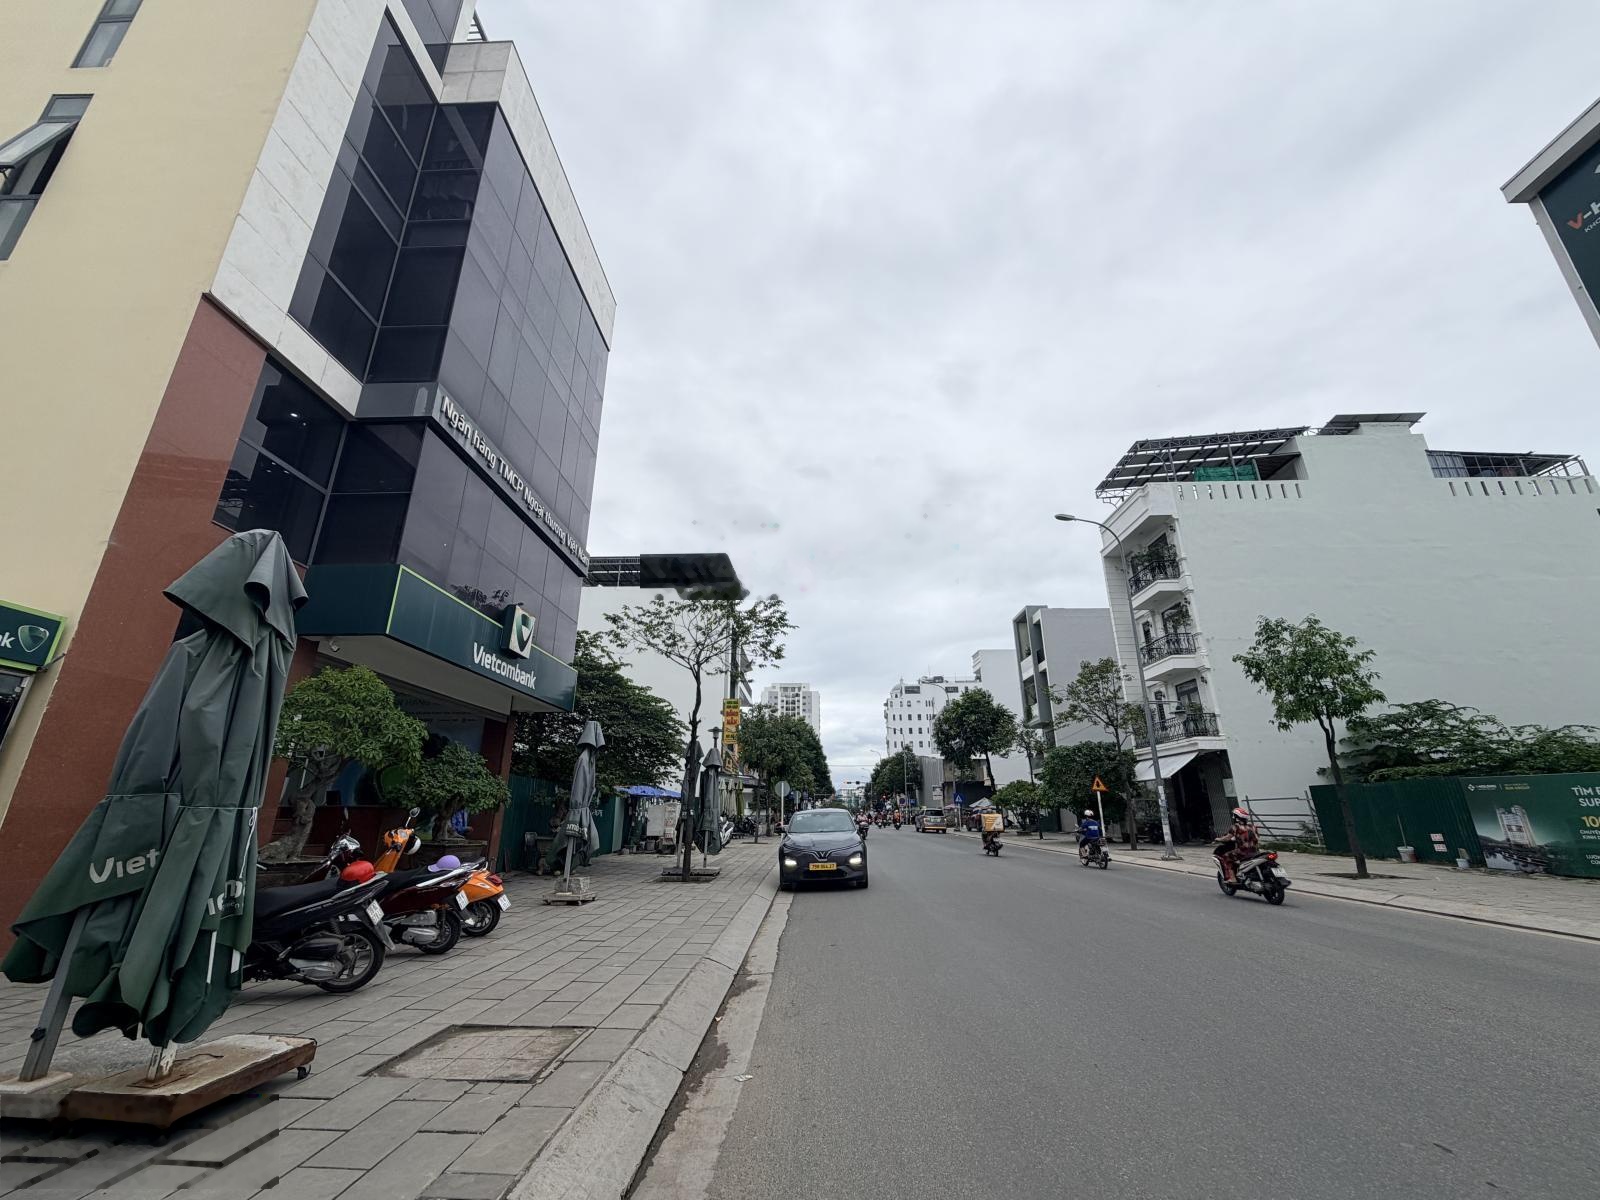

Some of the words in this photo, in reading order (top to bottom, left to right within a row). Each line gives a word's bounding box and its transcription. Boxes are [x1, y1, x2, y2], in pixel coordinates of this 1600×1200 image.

[442, 396, 472, 439] Ngân
[472, 430, 497, 469] hàng
[497, 457, 524, 492] TMCP
[524, 487, 545, 518] Ngoại
[473, 641, 537, 690] Vietcombank
[1571, 785, 1594, 796] TÌM
